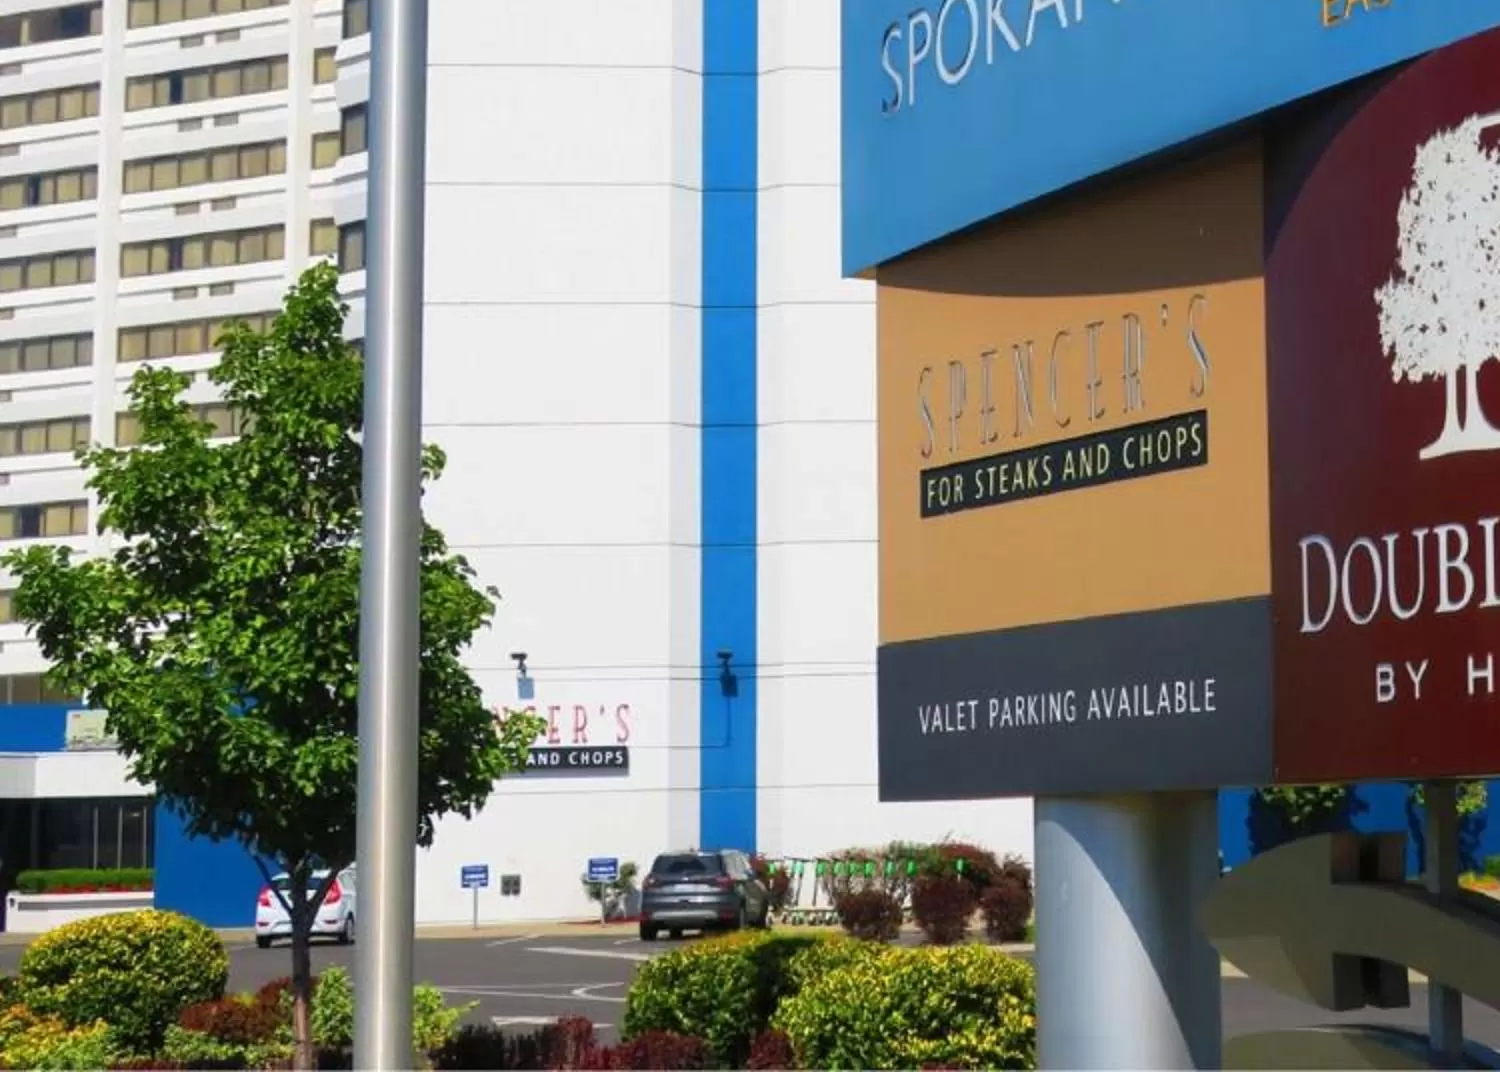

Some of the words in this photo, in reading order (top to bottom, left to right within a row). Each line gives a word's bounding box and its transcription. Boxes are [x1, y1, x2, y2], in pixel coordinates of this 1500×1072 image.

[918, 293, 1211, 459] SPENCER'S
[926, 474, 965, 510] FOR
[975, 452, 1053, 499] STEAKS
[1062, 443, 1111, 480] AND
[1122, 420, 1203, 470] CHOPS
[918, 699, 980, 736] VALET
[988, 688, 1077, 731] PARKING
[1087, 678, 1218, 719] AVAILABLE
[1376, 659, 1429, 703] BY
[526, 751, 561, 766] AND
[568, 749, 624, 766] CHOPS
